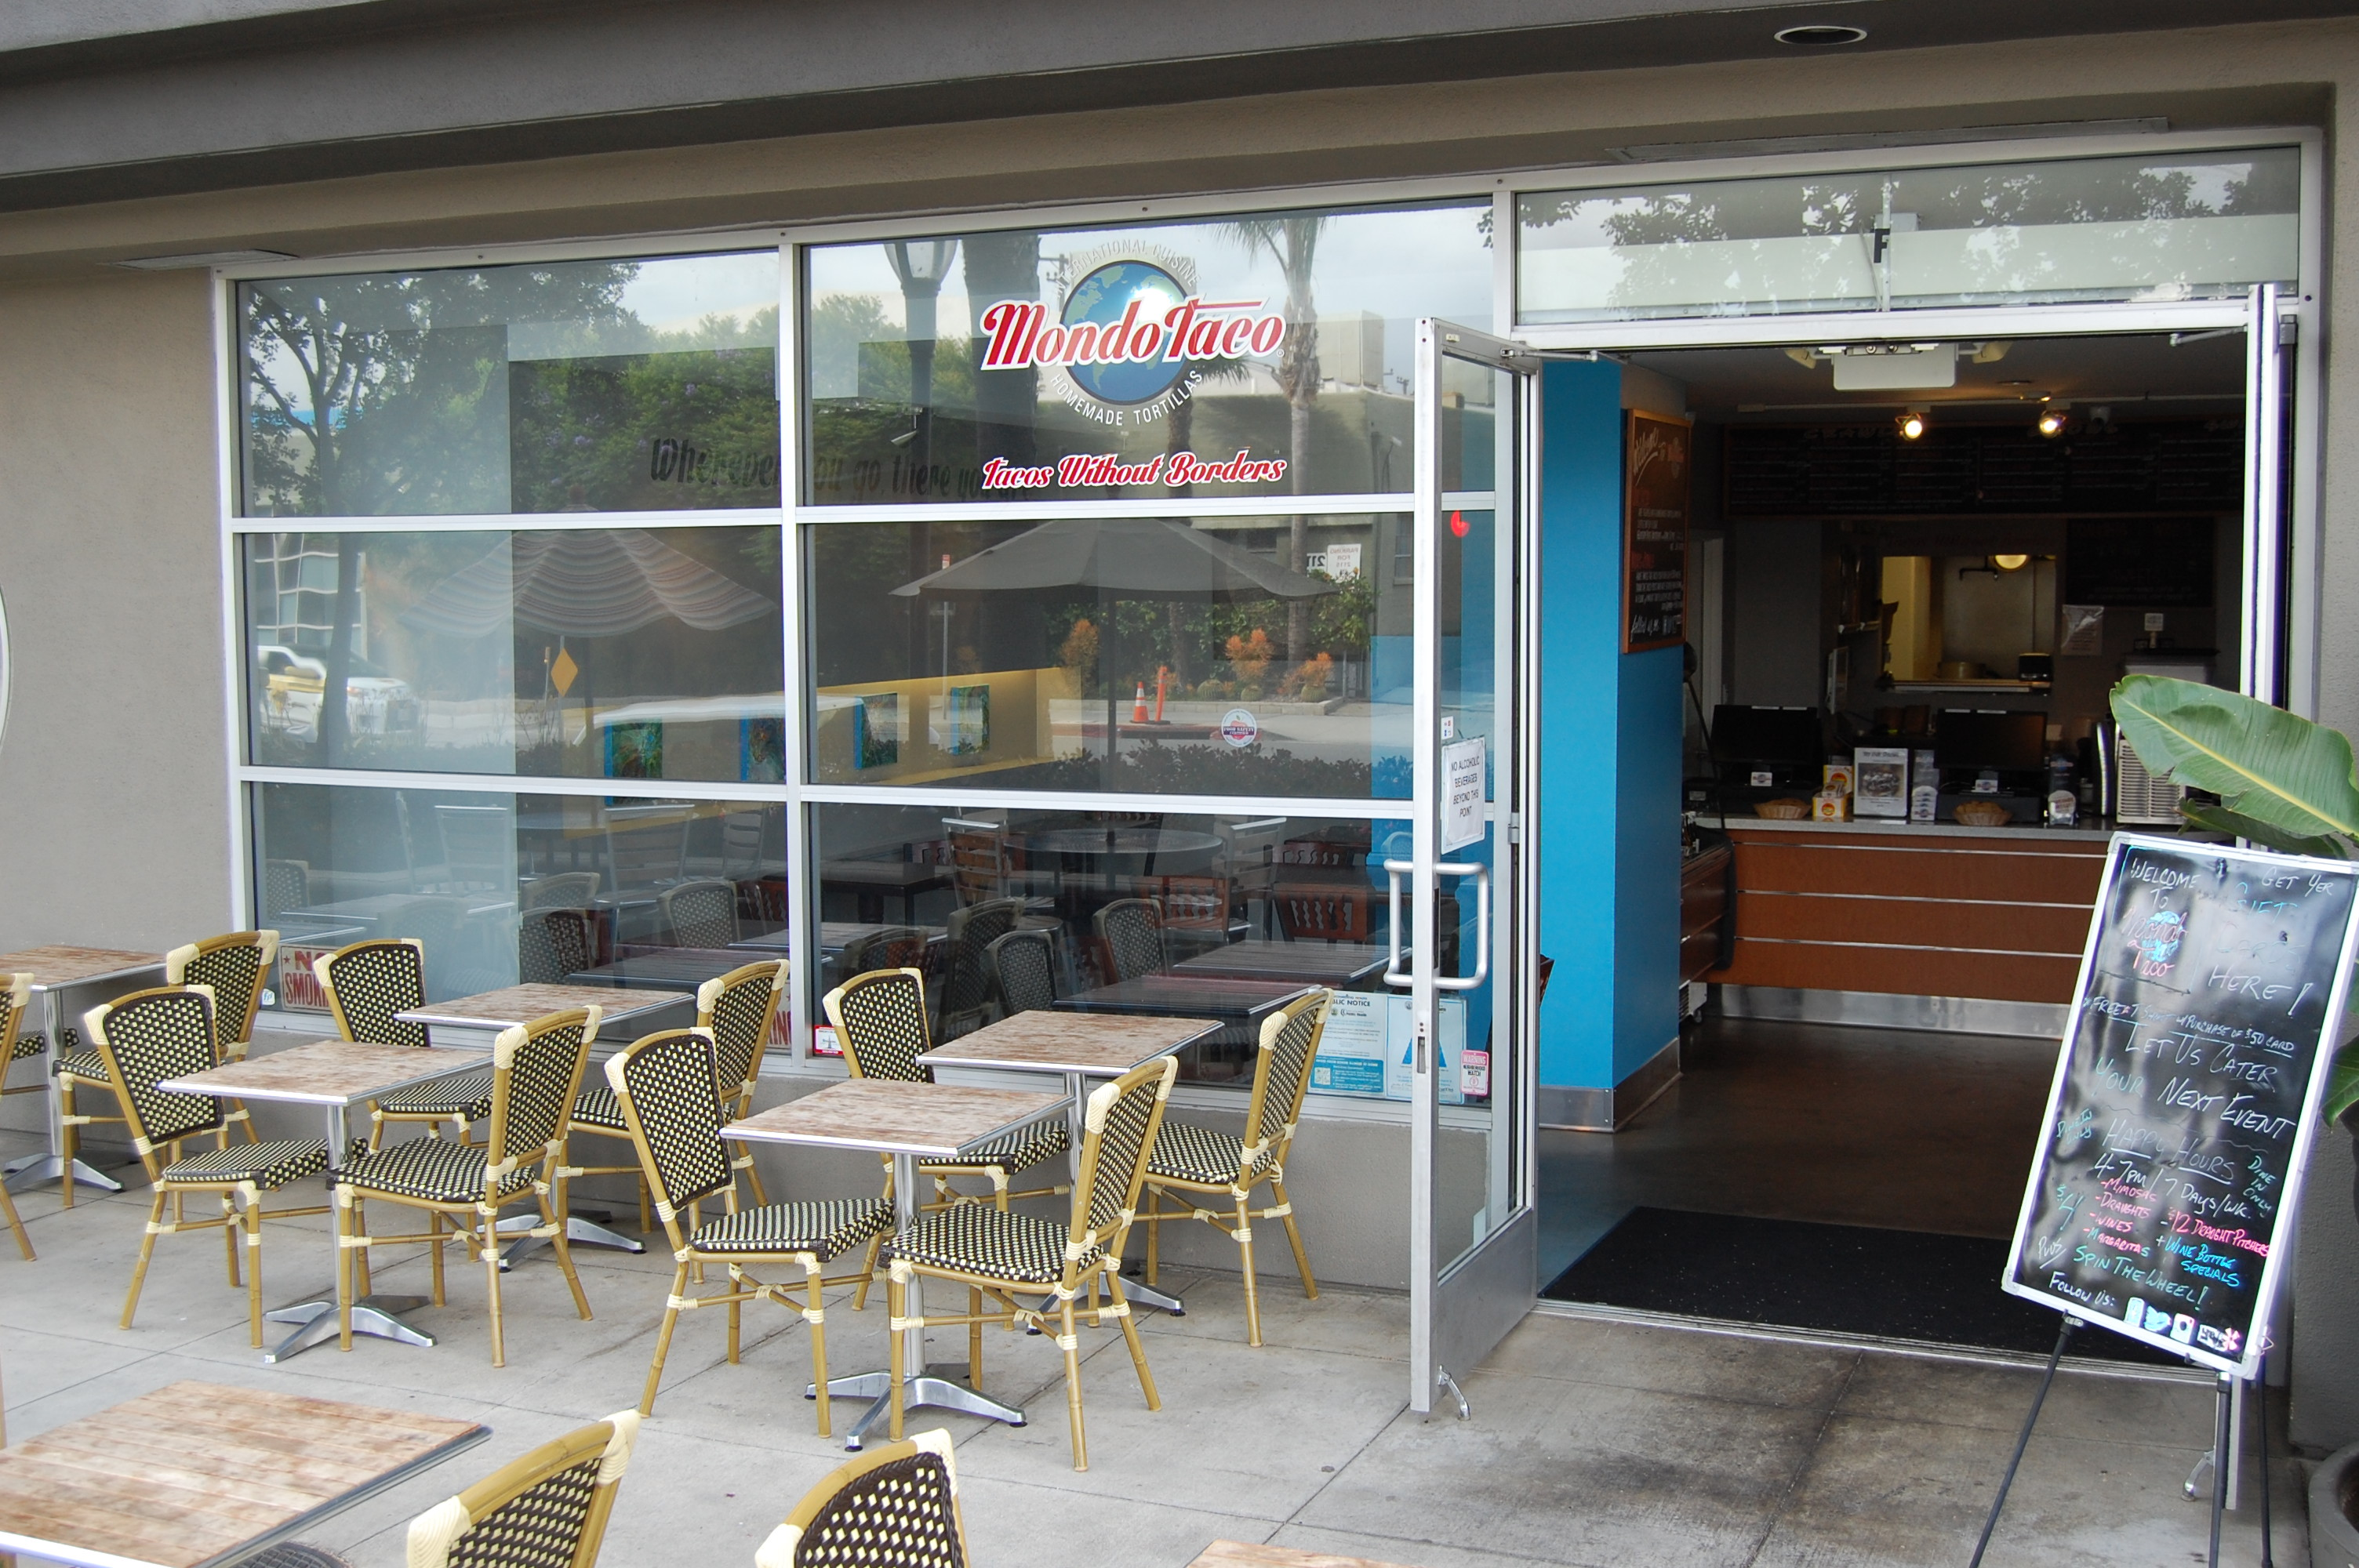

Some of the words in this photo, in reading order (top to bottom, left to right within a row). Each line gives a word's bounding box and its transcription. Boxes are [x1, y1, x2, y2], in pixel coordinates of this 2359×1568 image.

[1056, 238, 1148, 299] INTERNATIONAL
[1153, 243, 1201, 288] CUISINE
[981, 297, 1165, 369] Mondo
[1162, 293, 1285, 364] Taco
[1050, 374, 1124, 426] HOMEMADE
[1133, 368, 1203, 426] TORTILLAS
[813, 456, 843, 492] ou
[982, 458, 1053, 489] Tacos
[1058, 452, 1165, 487] Without
[1164, 448, 1287, 487] Borders
[1451, 761, 1458, 771] NO
[1459, 756, 1480, 770] ALCOHOLIC
[1452, 791, 1470, 804] BEYOND
[1470, 789, 1479, 800] THIS
[1454, 773, 1478, 788] BEVERAGES
[1459, 806, 1472, 818] POINT
[2131, 858, 2201, 888] WELCOME
[2262, 866, 2299, 890] GET
[2305, 873, 2334, 897] YER
[285, 972, 329, 1007] SMOK
[2089, 996, 2126, 1015] FREE
[2231, 1029, 2244, 1039] OF
[2245, 1028, 2265, 1044] $50
[2266, 1037, 2295, 1052] CARD
[2125, 1022, 2175, 1058] LET
[2175, 1033, 2202, 1065] US
[2209, 1044, 2278, 1091] CATER
[2092, 1057, 2146, 1098] YOUR
[2157, 1076, 2224, 1112] NEXT
[2220, 1092, 2296, 1138] EVENT
[2102, 1117, 2167, 1152] HAPPY
[2172, 1137, 2234, 1181] HOURS
[2248, 1154, 2277, 1185] DINE
[2250, 1178, 2266, 1192] IN
[2242, 1187, 2273, 1219] ONLY
[2073, 1245, 2110, 1270] SPIN
[2115, 1255, 2146, 1283] THE
[2165, 1236, 2194, 1258] WINE
[2194, 1243, 2237, 1269] BOTTLE
[2049, 1271, 2092, 1301] FOLLOW
[2181, 1260, 2241, 1288] SPECIALS
